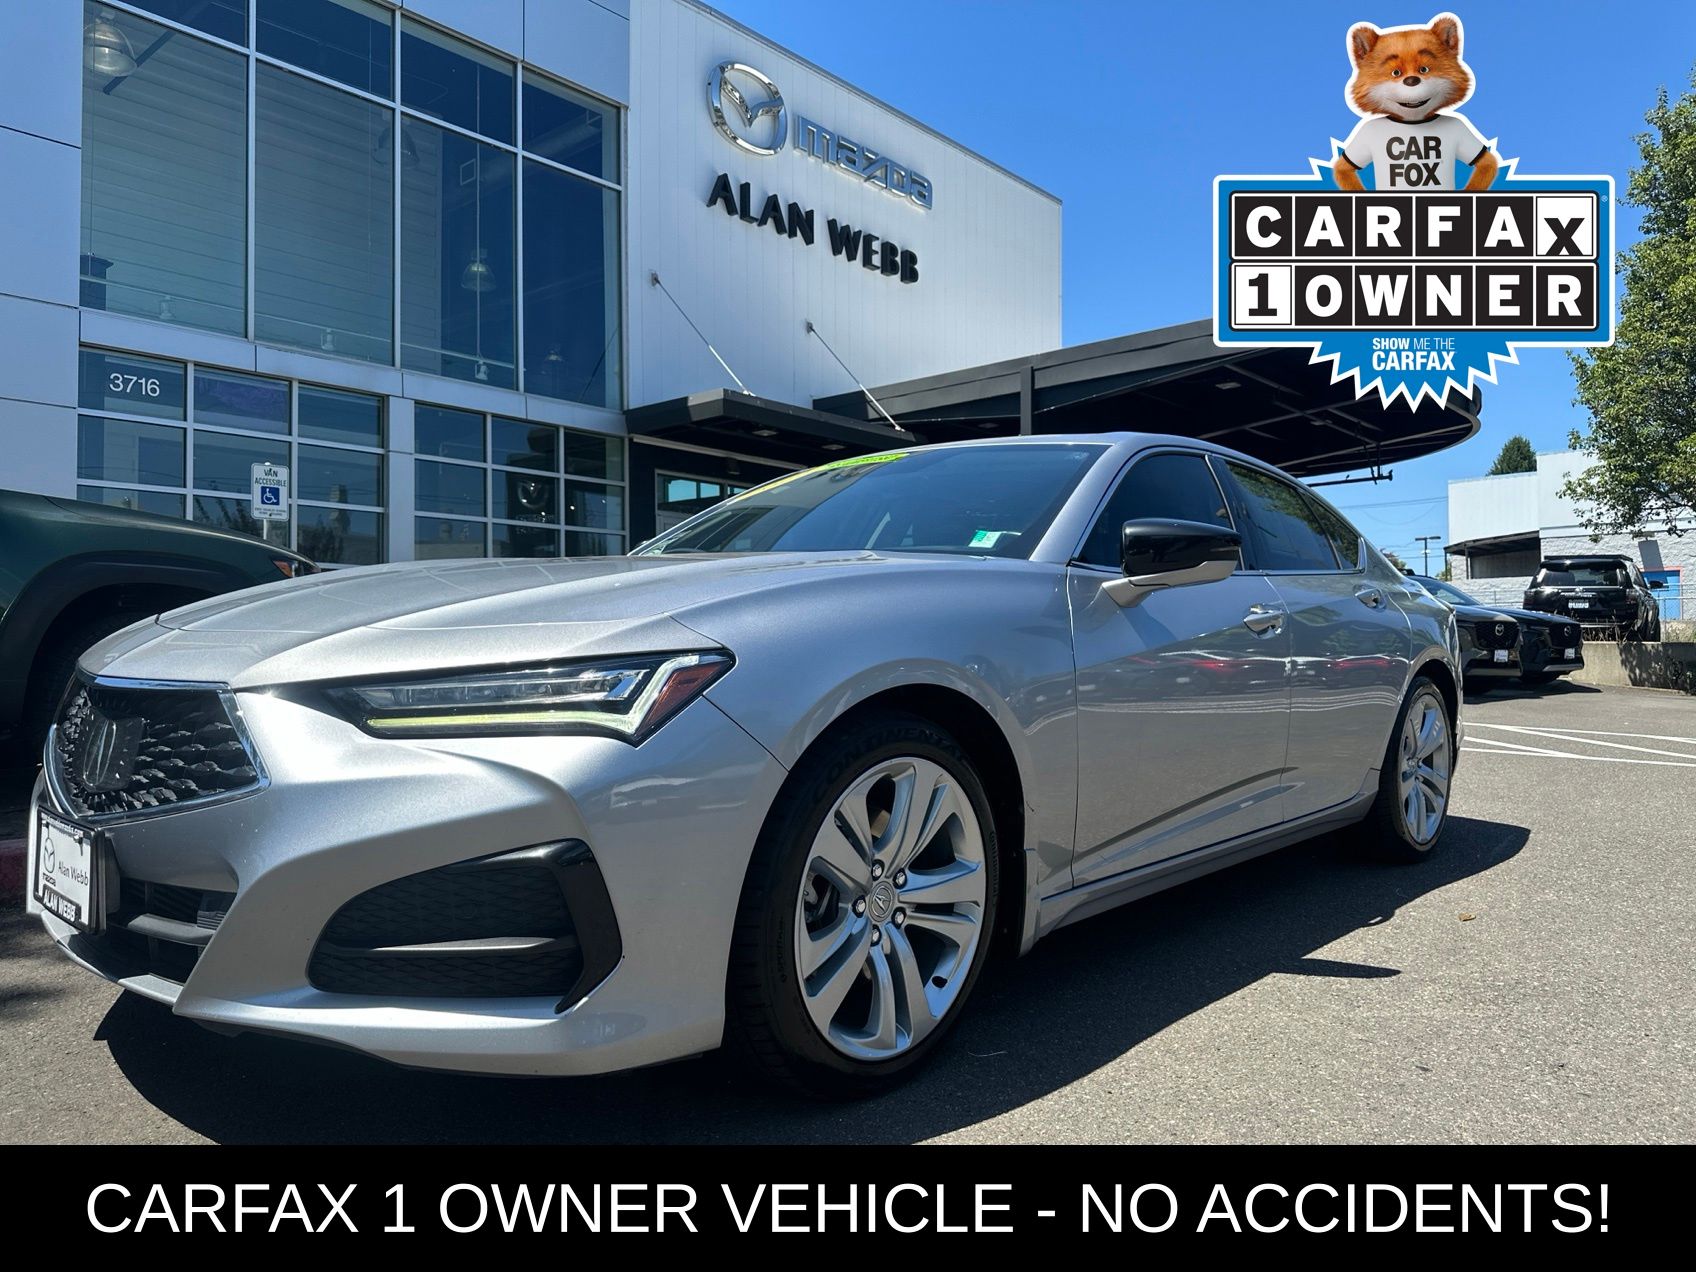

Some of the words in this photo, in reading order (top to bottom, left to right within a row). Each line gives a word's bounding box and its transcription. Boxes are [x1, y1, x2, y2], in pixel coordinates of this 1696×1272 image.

[793, 115, 933, 210] mazda
[706, 173, 815, 246] ALAN
[827, 218, 919, 284] WEBB
[109, 373, 160, 397] 3716
[254, 477, 288, 487] ACCESSIBLE
[263, 468, 278, 478] VAN
